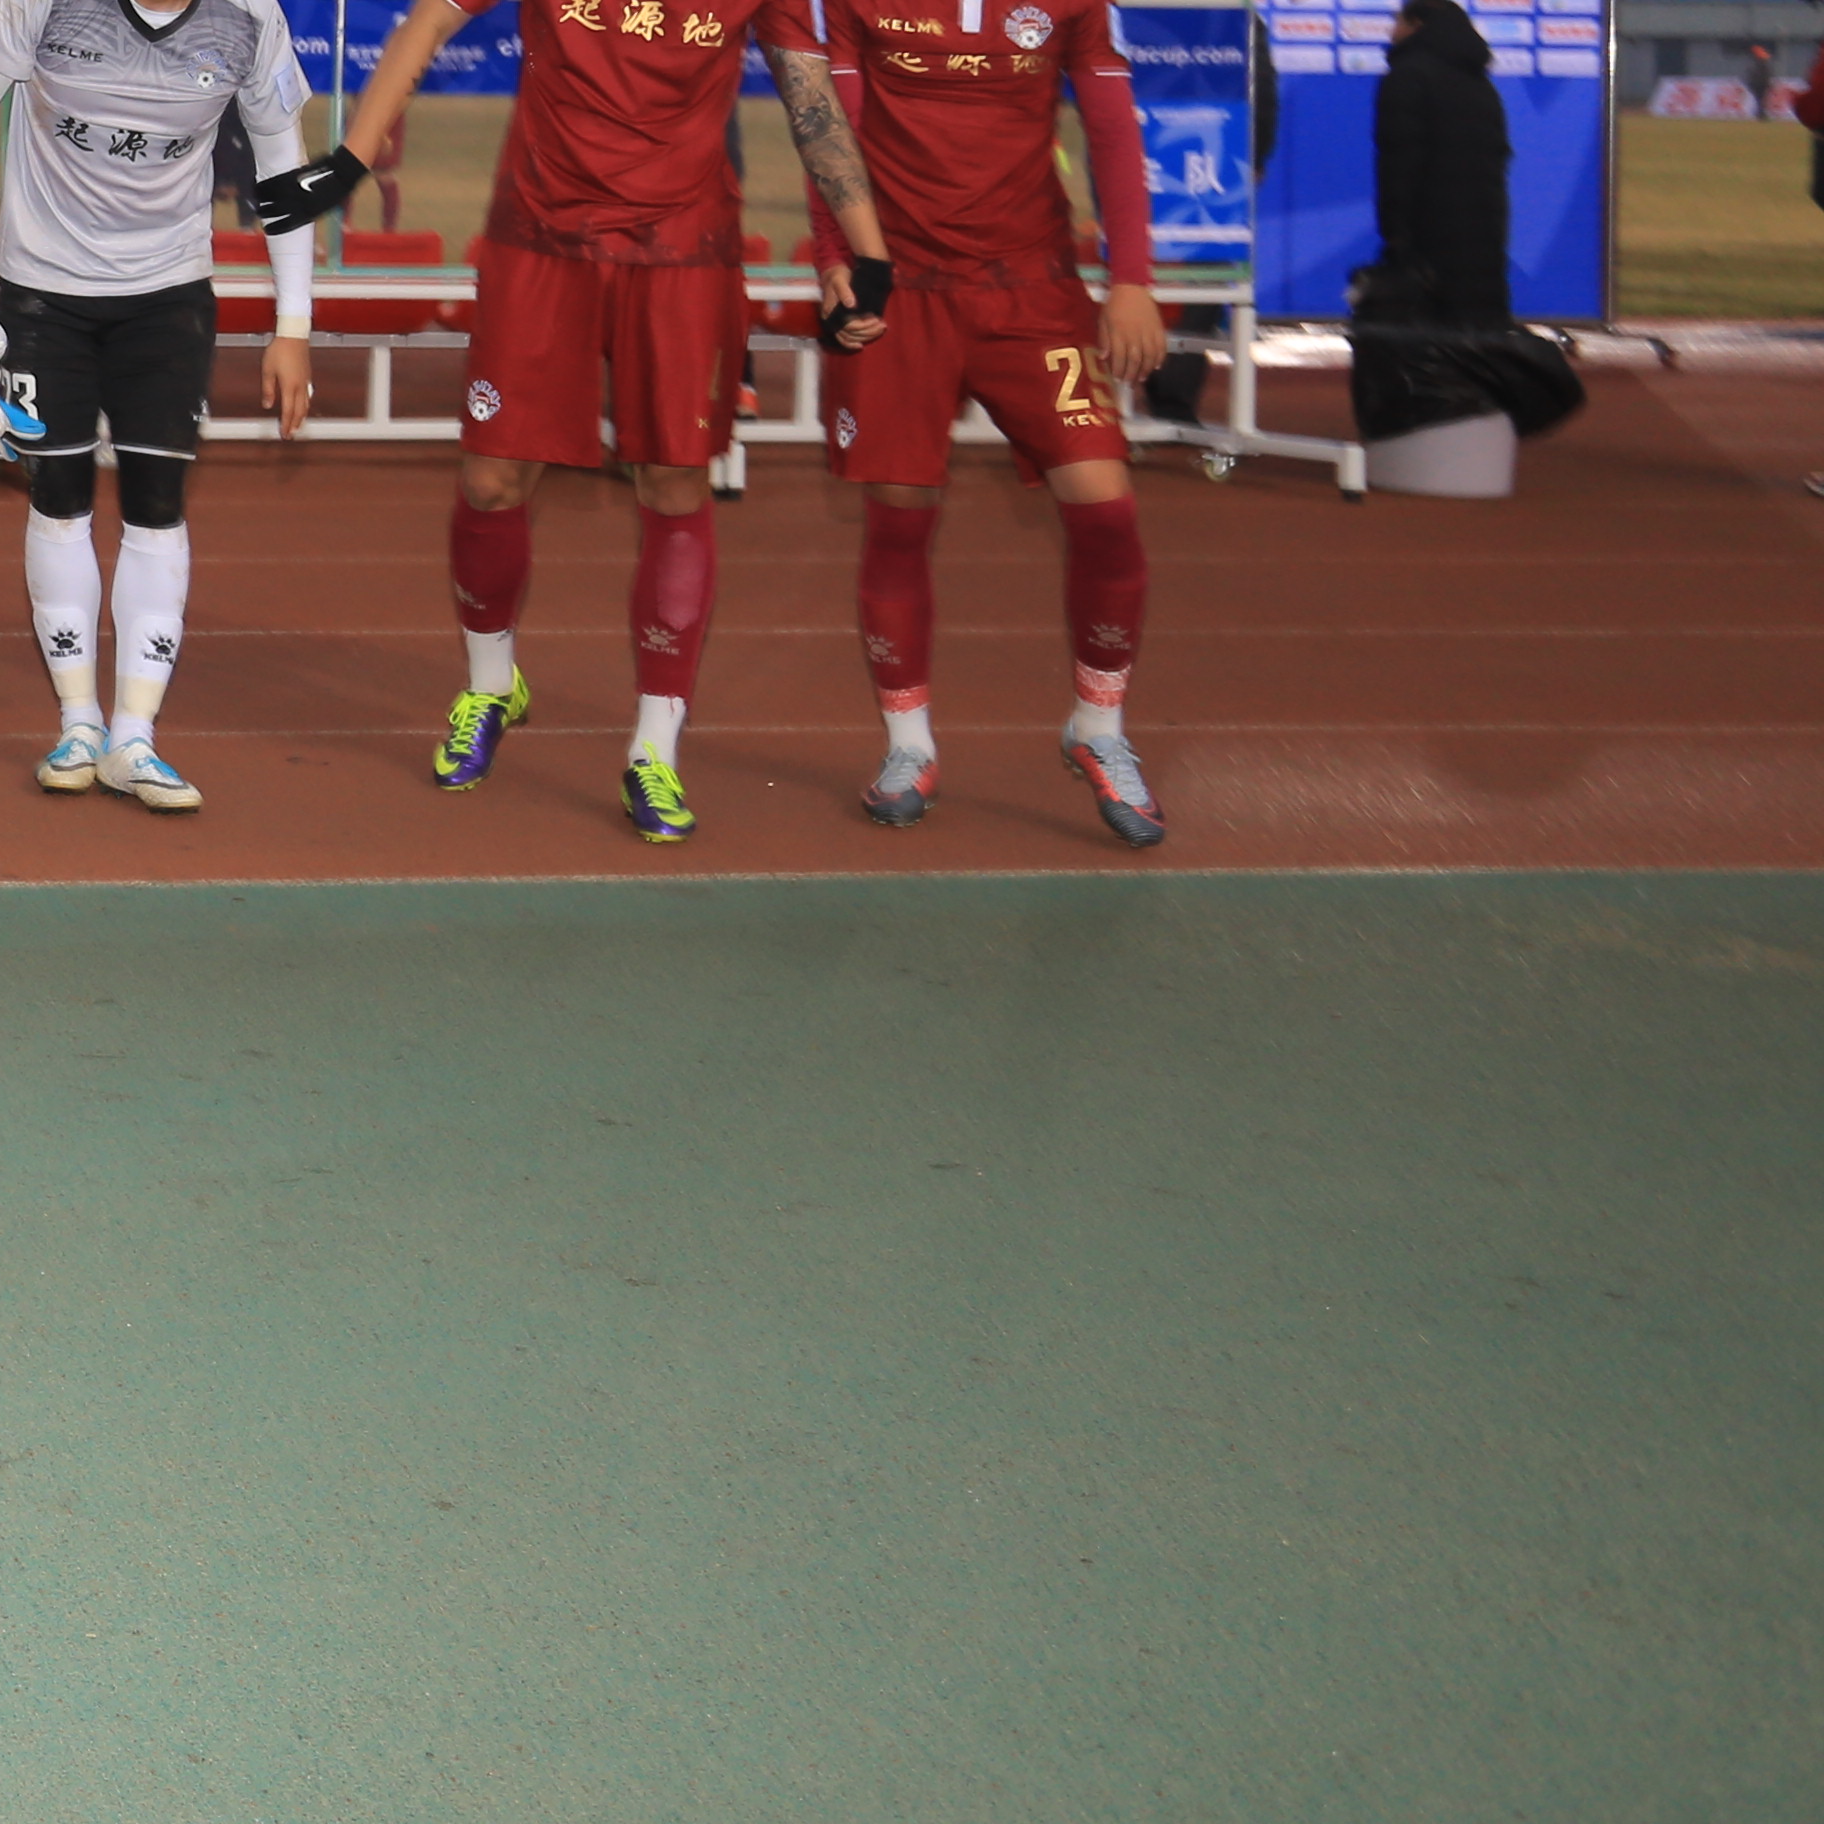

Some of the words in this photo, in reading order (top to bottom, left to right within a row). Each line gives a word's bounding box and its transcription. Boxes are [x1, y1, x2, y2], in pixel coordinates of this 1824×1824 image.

[47, 43, 104, 63] KELME
[1129, 45, 1243, 69] acup.com
[55, 117, 195, 162] 起源地
[1063, 413, 1104, 427] KEL
[49, 647, 82, 658] KELME
[641, 641, 680, 655] KELME
